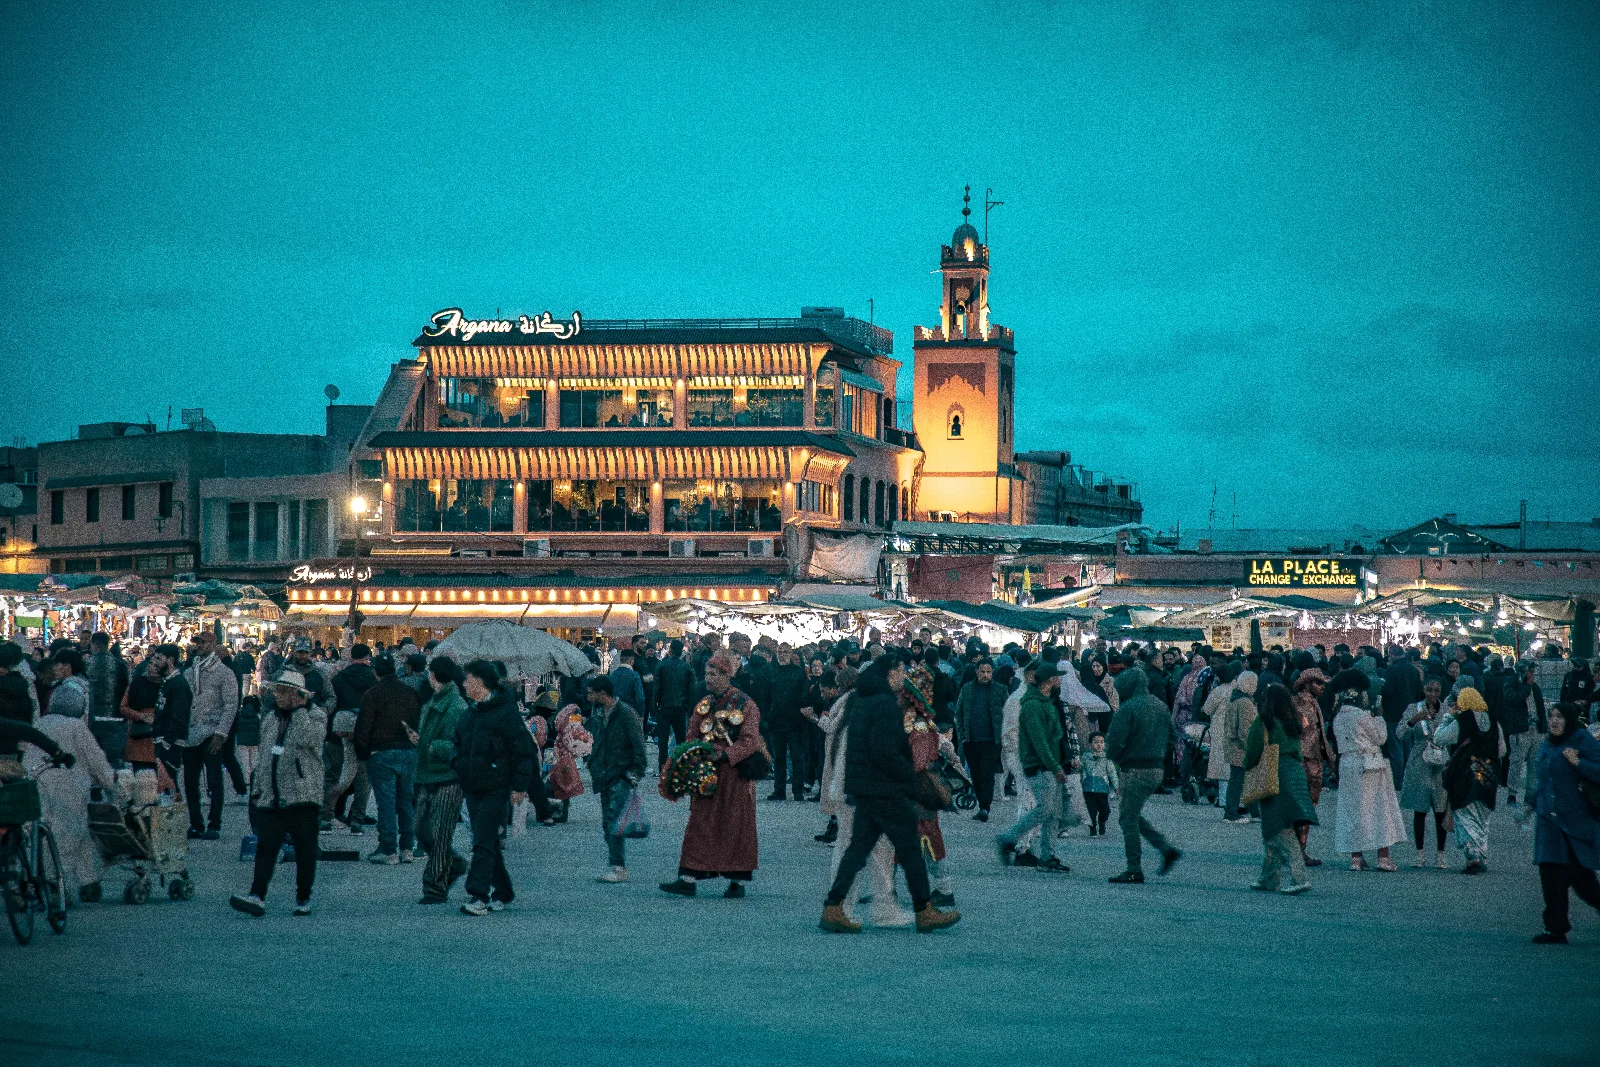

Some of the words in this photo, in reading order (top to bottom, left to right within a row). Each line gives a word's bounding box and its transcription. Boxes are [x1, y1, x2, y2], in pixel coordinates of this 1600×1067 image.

[423, 309, 513, 342] Argana
[1252, 560, 1274, 574] LA
[1283, 560, 1340, 574] PLACE
[1249, 574, 1291, 585] CHANGE
[1302, 574, 1357, 585] EXCHANGE
